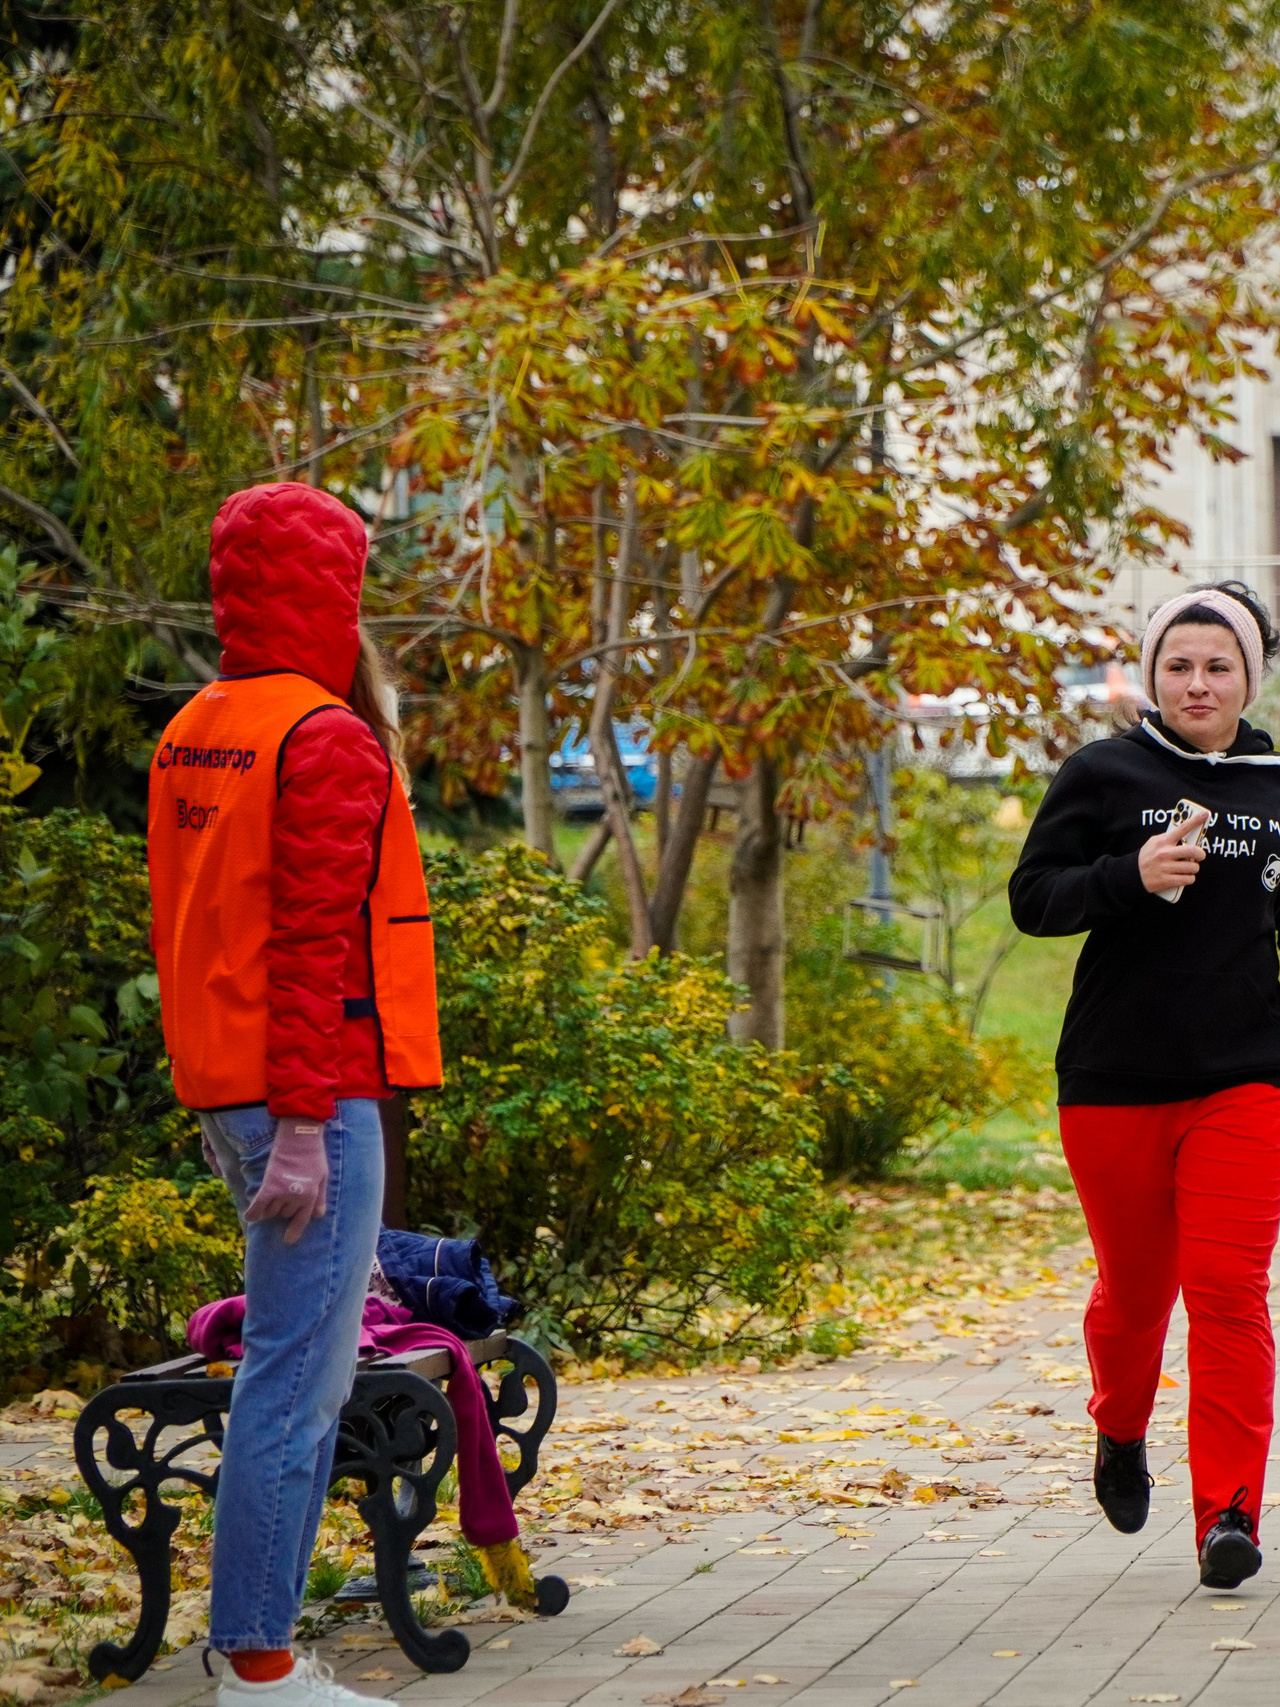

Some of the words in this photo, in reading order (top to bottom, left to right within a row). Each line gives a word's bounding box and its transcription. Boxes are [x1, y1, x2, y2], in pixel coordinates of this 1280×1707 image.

[158, 742, 256, 776] Оганизатор
[1141, 809, 1219, 827] ПОТУ
[1227, 813, 1262, 831] ЧТО
[1199, 836, 1256, 858] АНДА!
